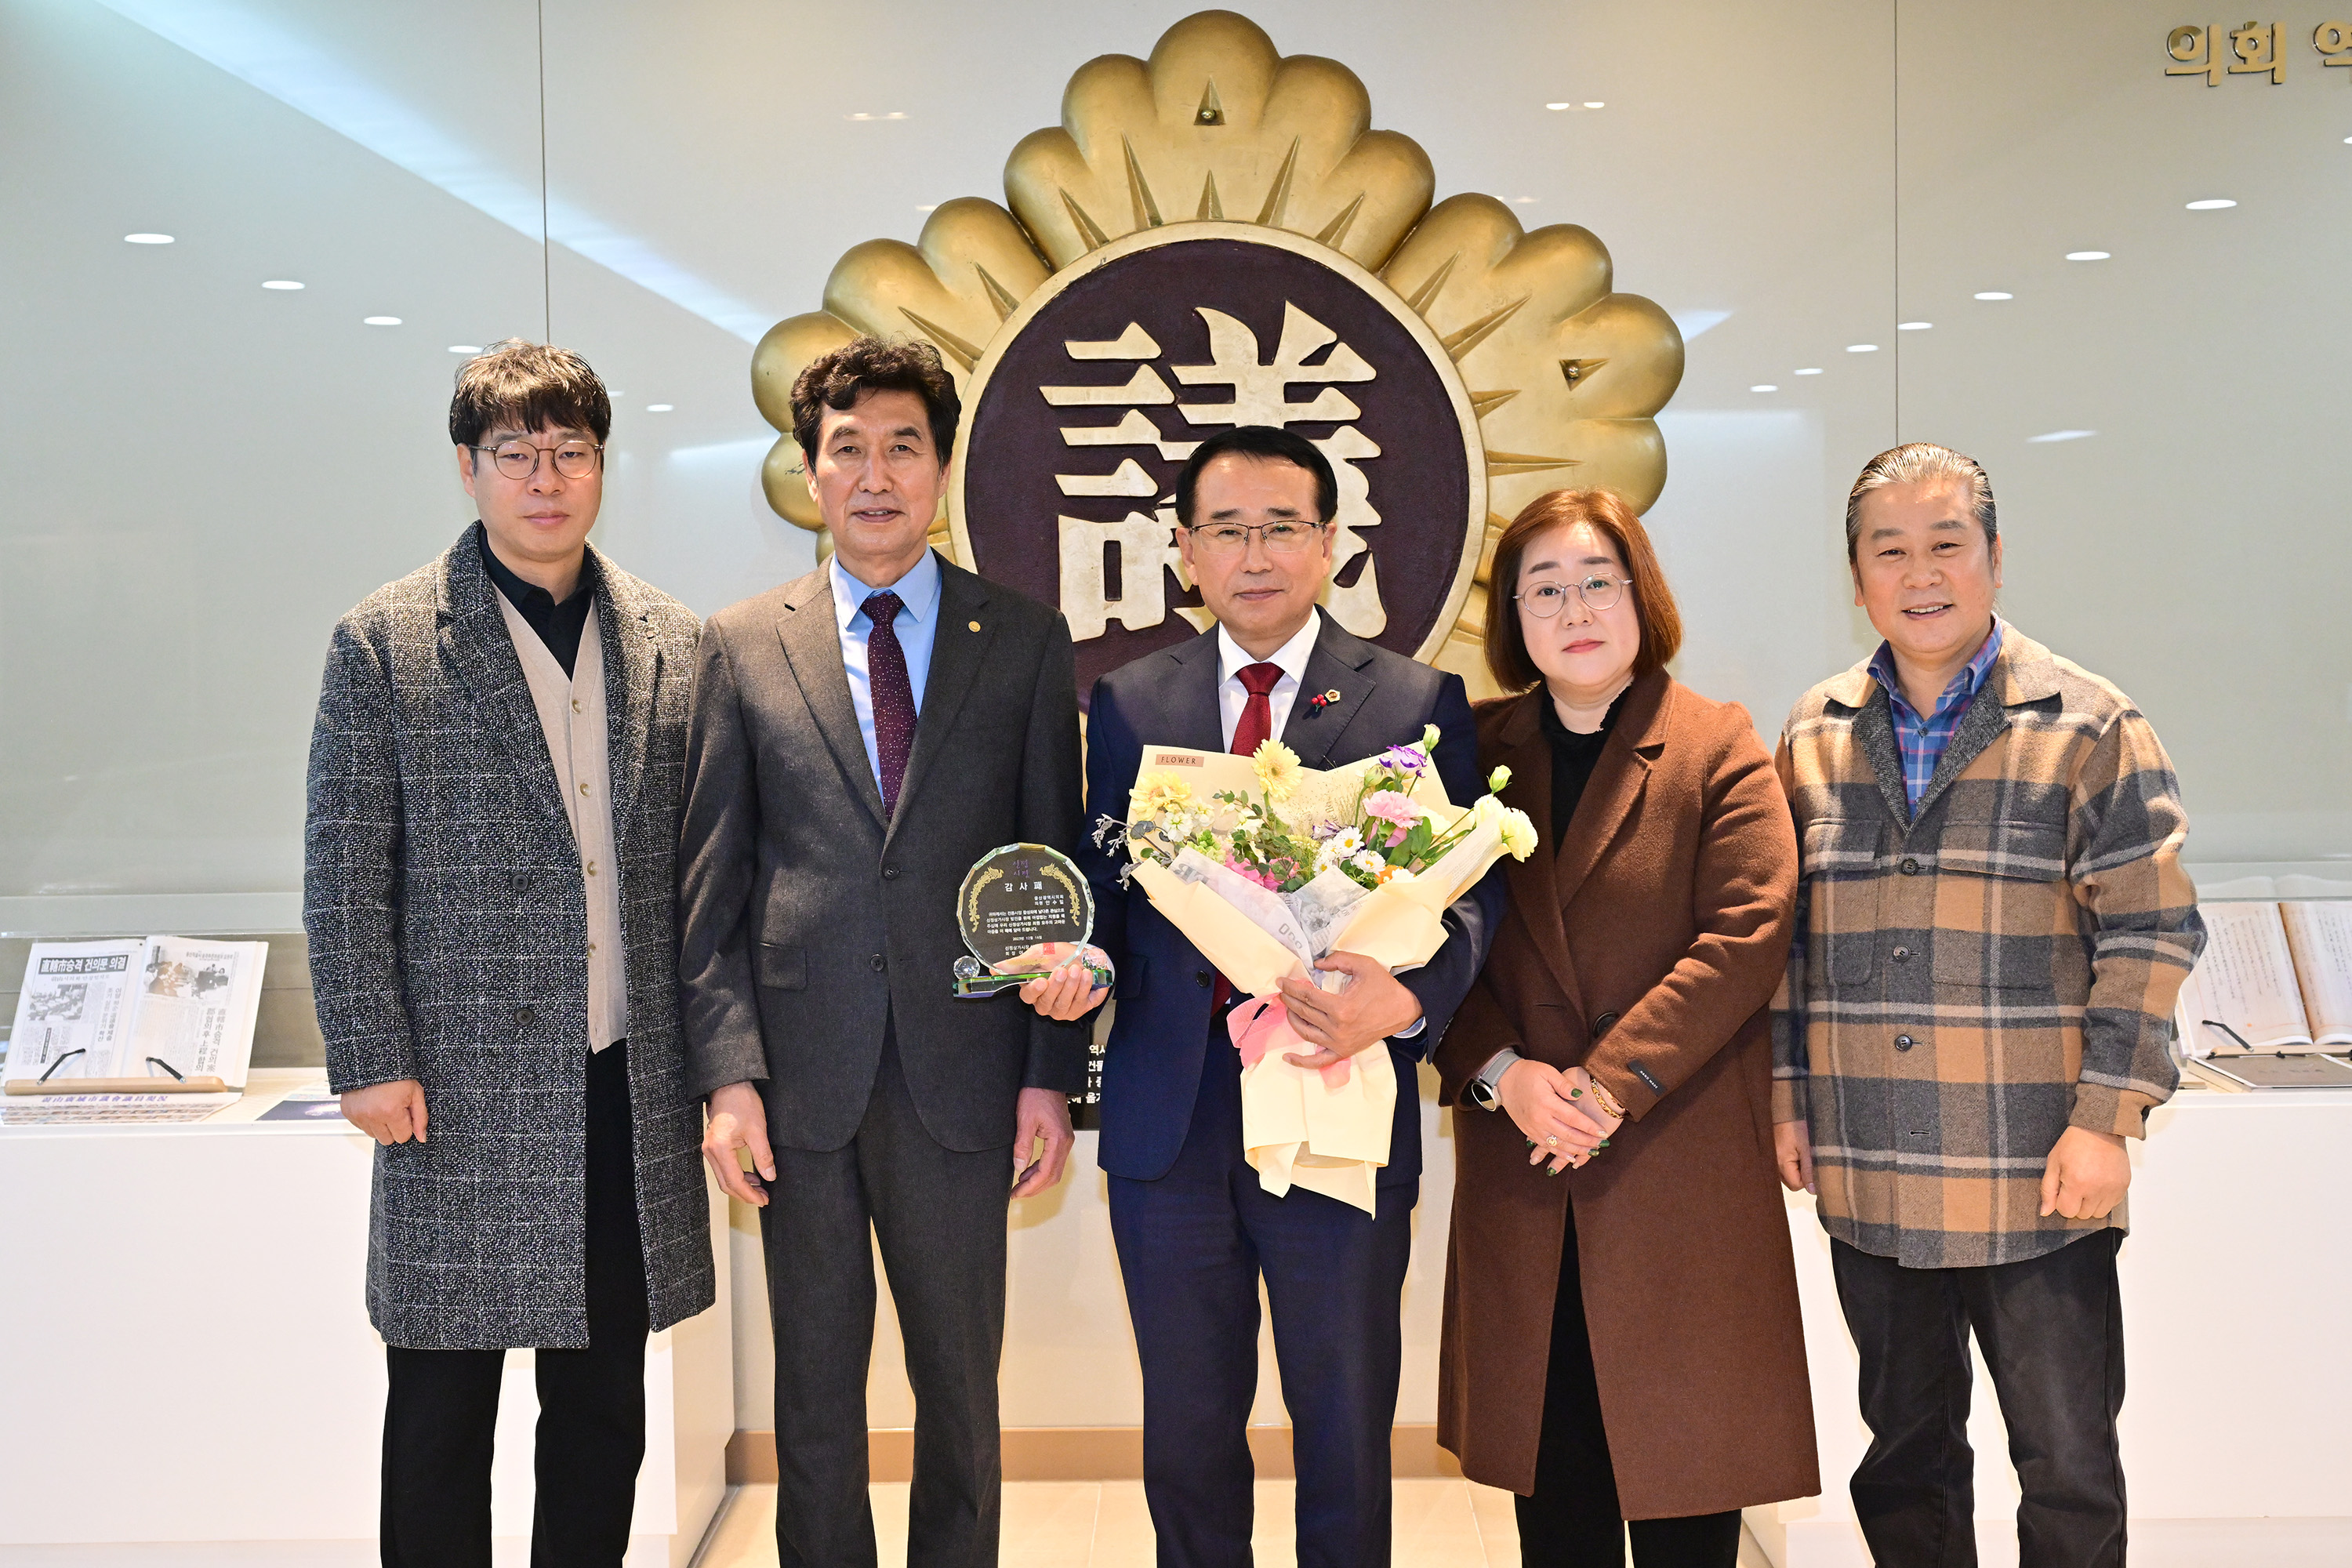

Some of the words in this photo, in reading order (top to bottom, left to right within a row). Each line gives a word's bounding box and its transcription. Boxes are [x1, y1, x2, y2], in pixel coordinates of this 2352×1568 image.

[2165, 21, 2286, 86] 의회
[85, 957, 108, 971] 건의문
[109, 956, 127, 970] 의결
